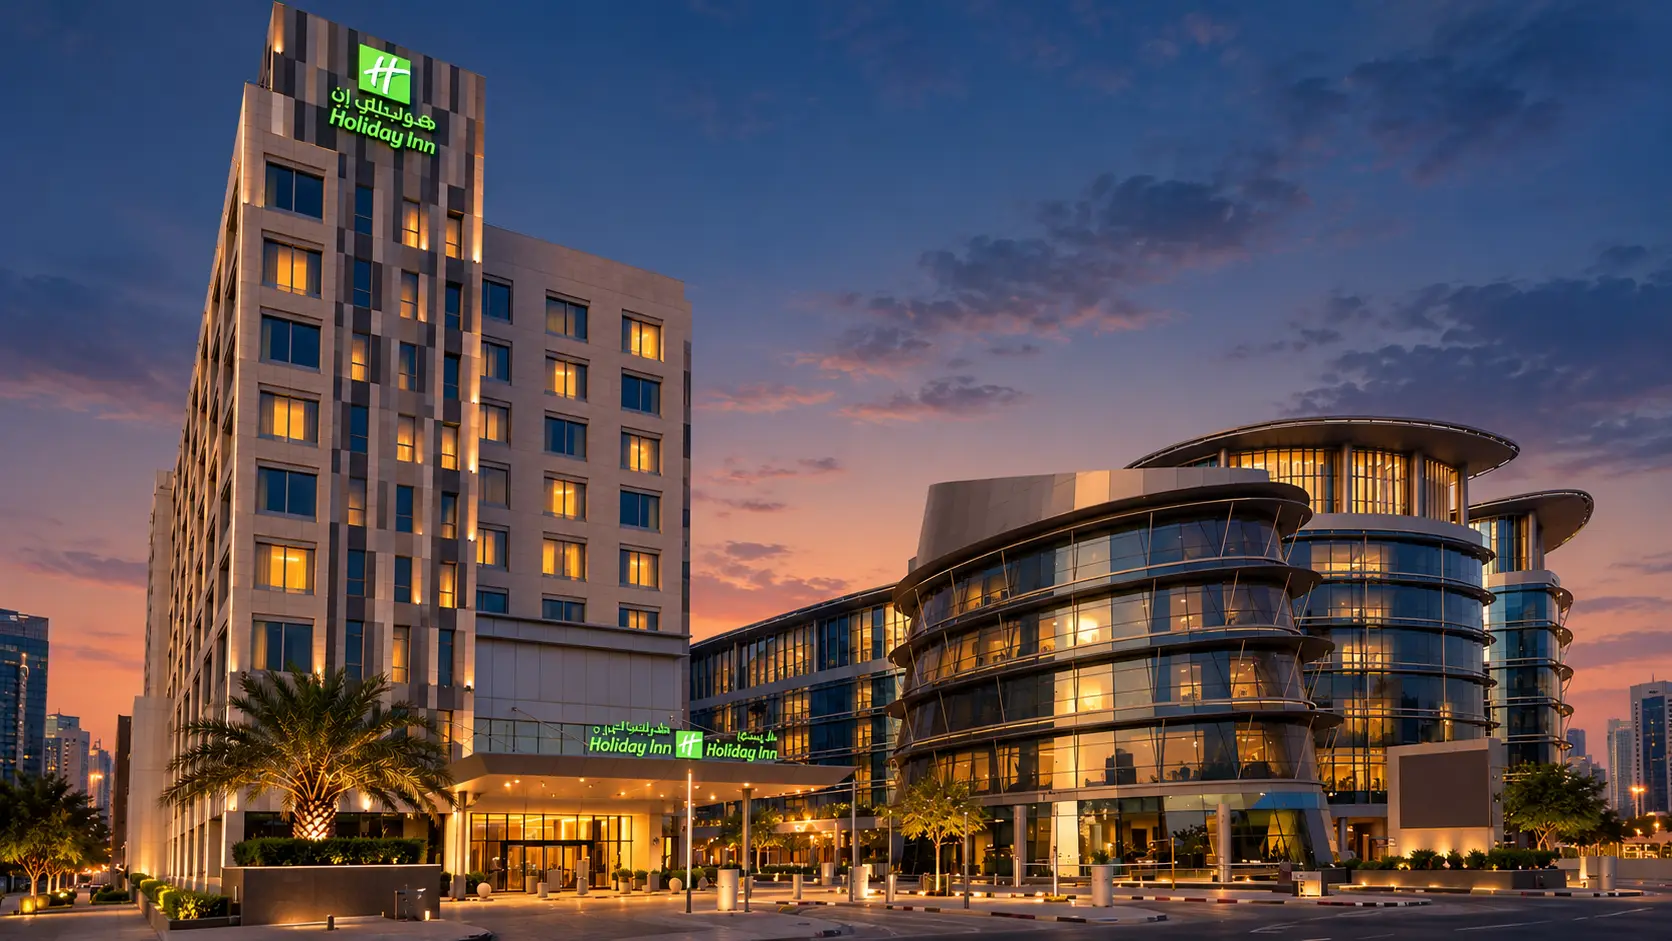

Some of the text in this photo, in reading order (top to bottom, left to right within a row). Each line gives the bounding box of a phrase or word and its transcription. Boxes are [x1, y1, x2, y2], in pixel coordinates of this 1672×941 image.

[329, 107, 436, 155] Holiday Inn
[589, 736, 671, 757] Holiday Inn
[758, 745, 778, 760] Inn
